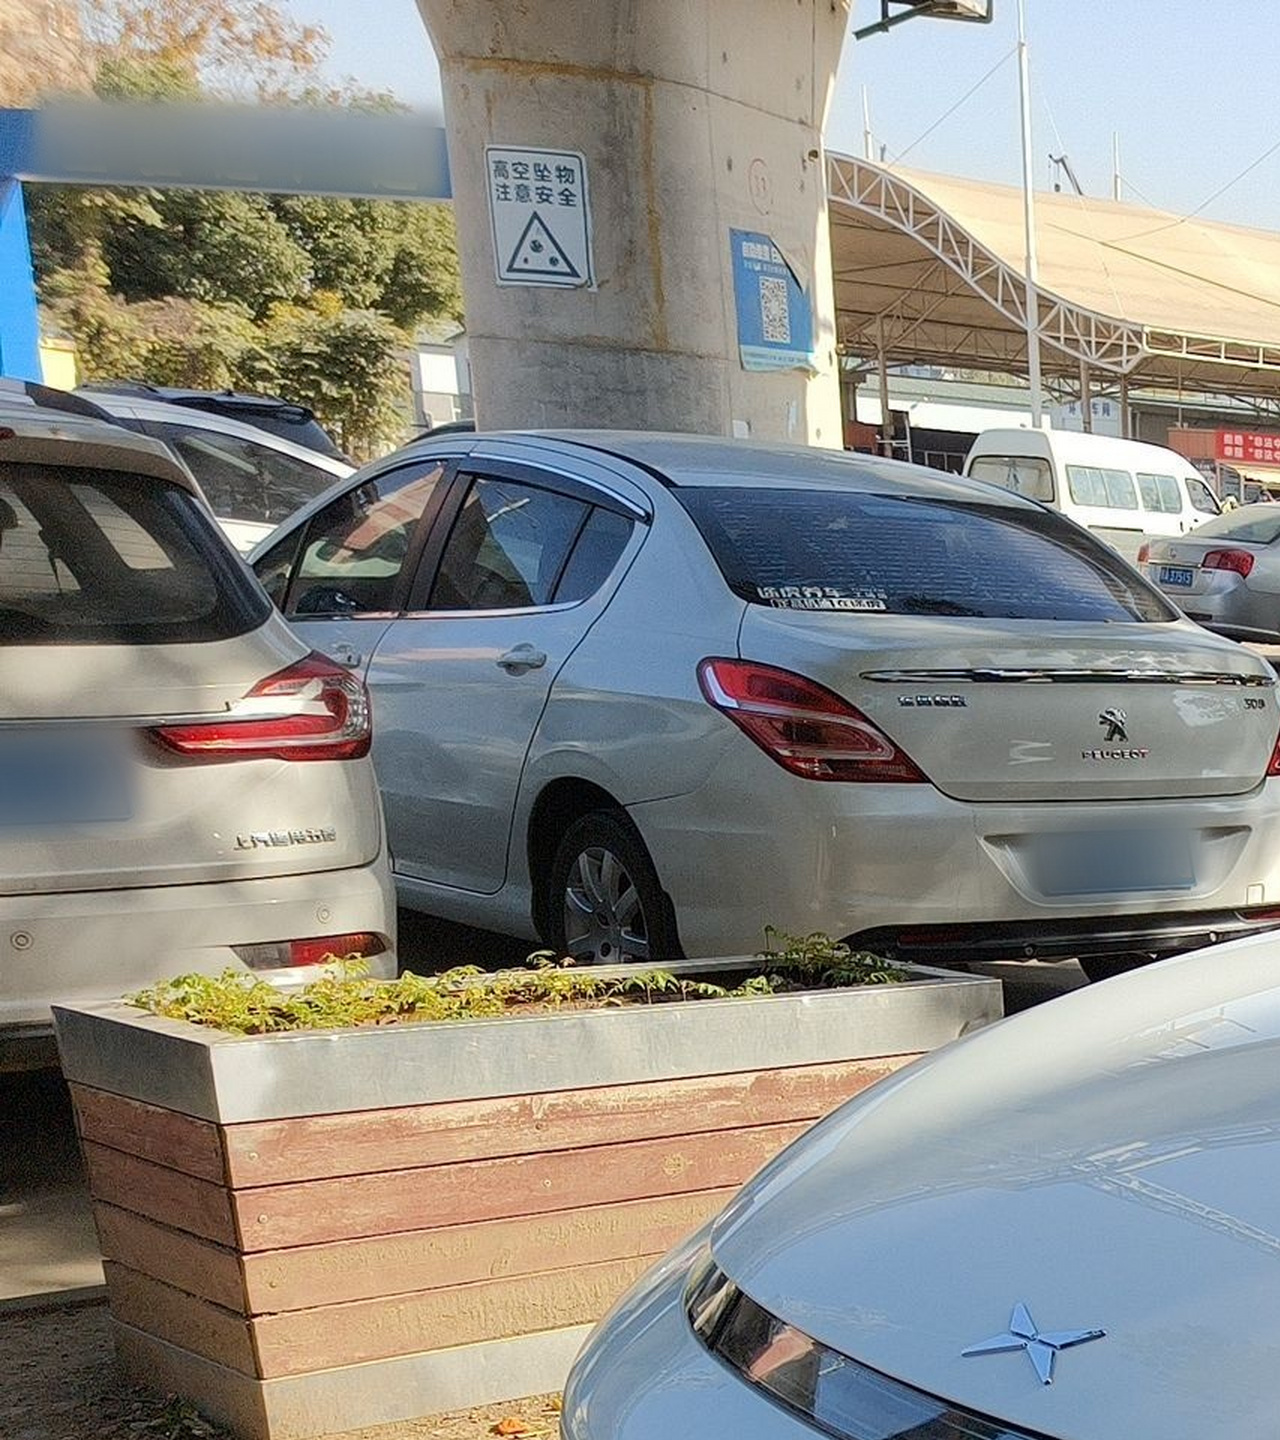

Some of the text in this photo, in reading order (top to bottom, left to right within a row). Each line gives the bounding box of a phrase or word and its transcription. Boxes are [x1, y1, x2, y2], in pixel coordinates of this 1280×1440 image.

[492, 160, 576, 185] 高空坠物
[495, 182, 578, 208] 注意安全
[1081, 748, 1150, 760] PEUGEOT
